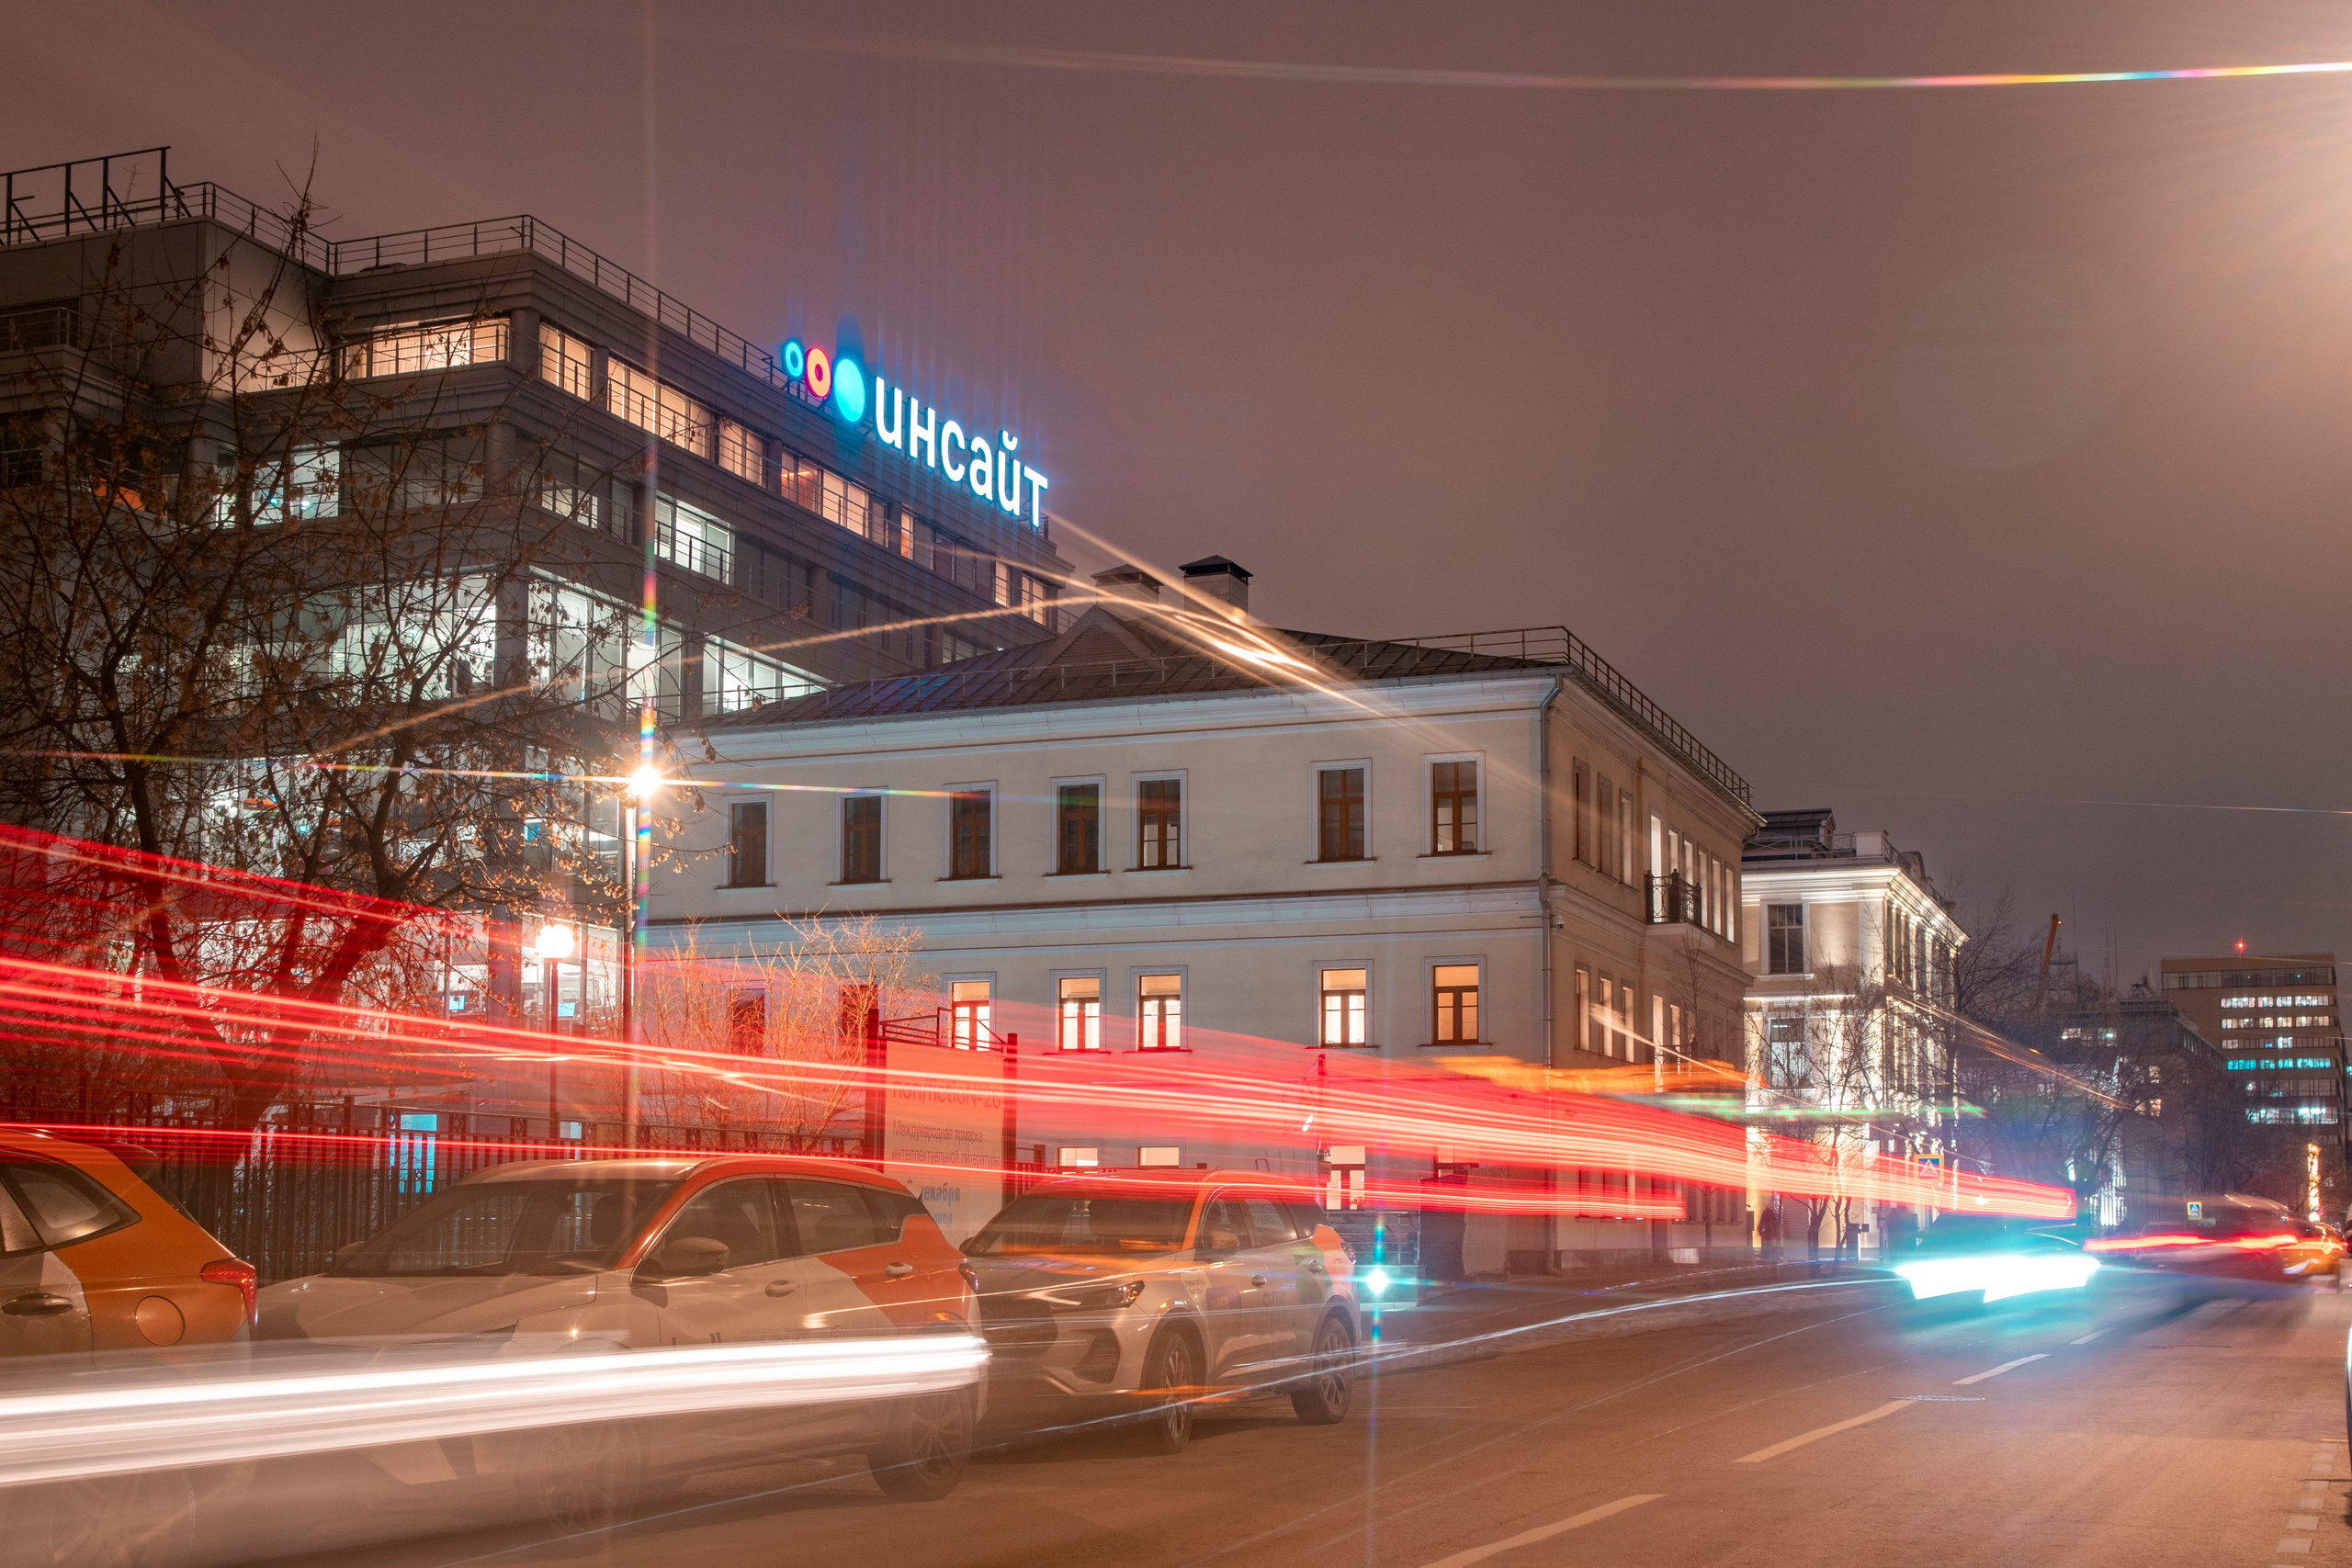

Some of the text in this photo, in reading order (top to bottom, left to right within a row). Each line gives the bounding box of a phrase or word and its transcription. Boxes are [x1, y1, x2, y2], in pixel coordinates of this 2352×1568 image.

[876, 377, 1048, 528] инсайт
[893, 1120, 983, 1144] Международная ярмарка
[891, 1148, 1001, 1168] интеллектуальной литературы
